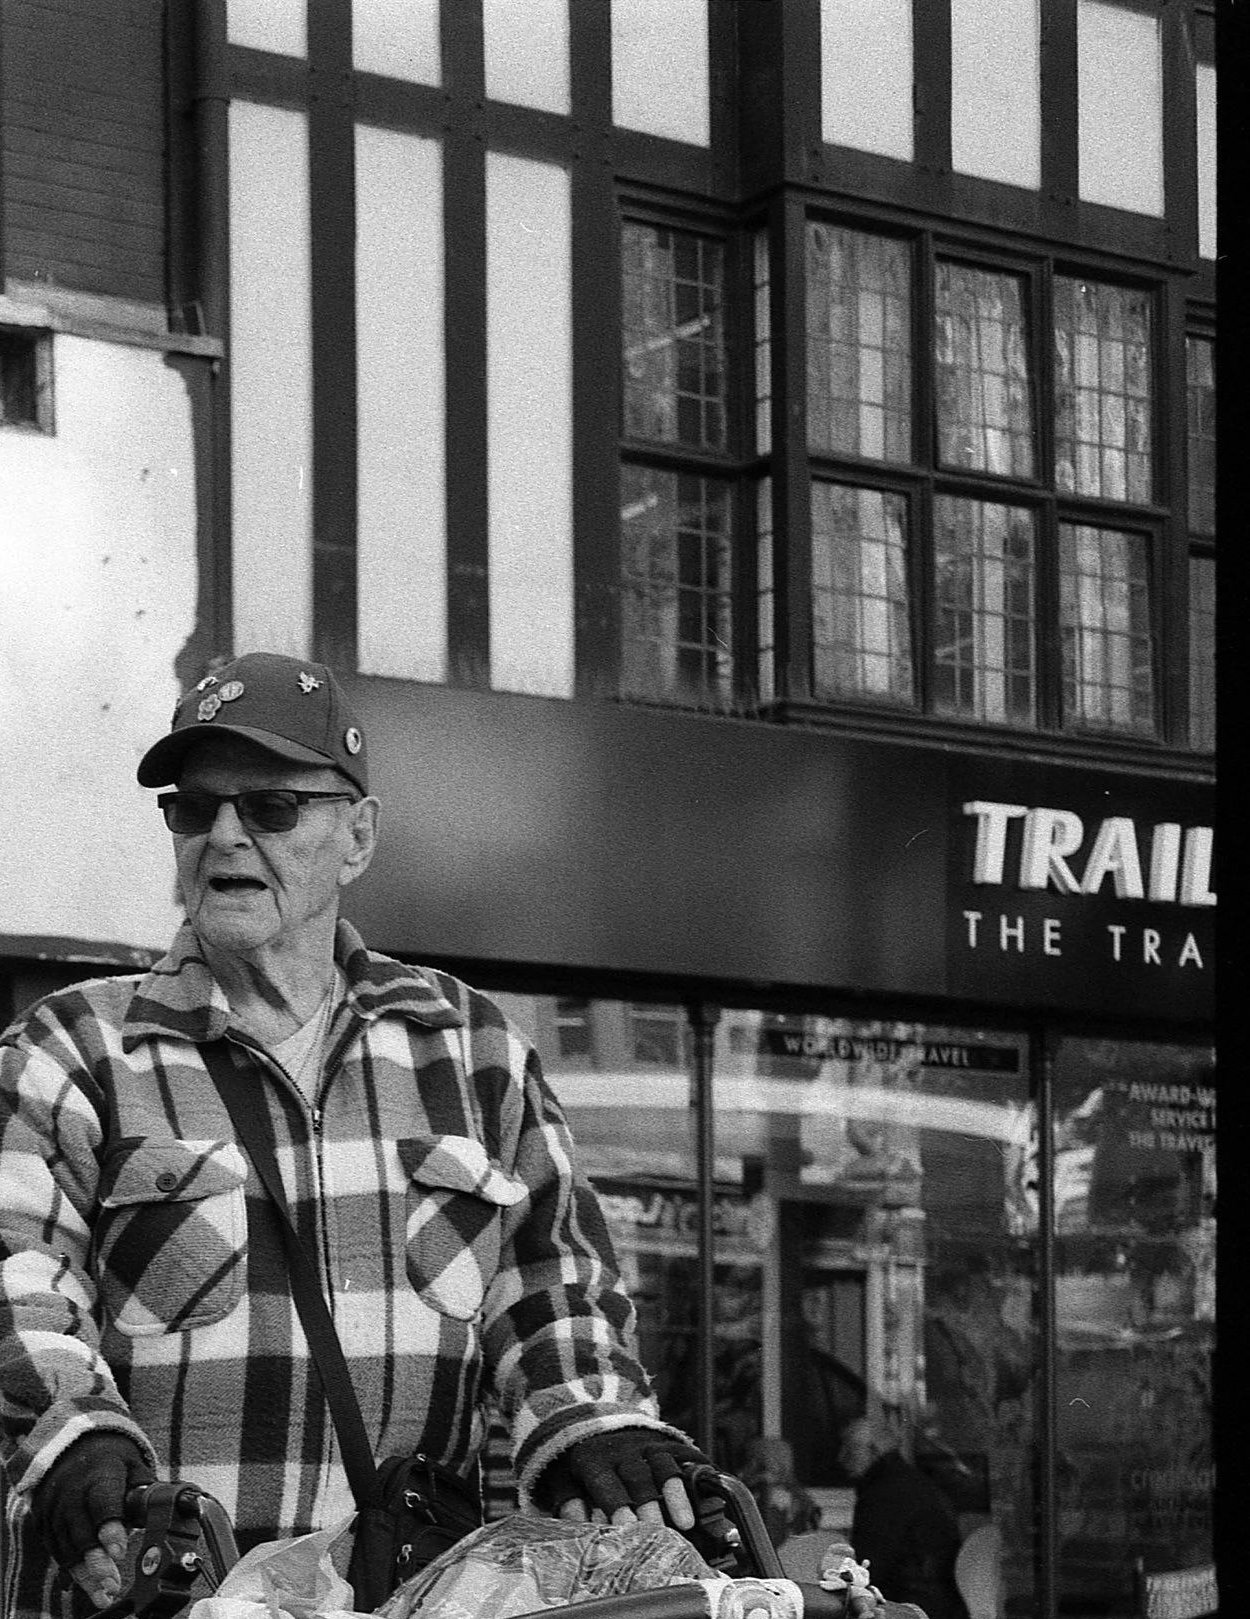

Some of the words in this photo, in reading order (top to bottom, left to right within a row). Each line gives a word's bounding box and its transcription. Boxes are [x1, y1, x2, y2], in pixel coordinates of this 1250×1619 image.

[963, 800, 1217, 907] TRAIL
[963, 910, 1062, 956] THE
[1107, 924, 1204, 969] TRA
[903, 1043, 969, 1067] RAVEL
